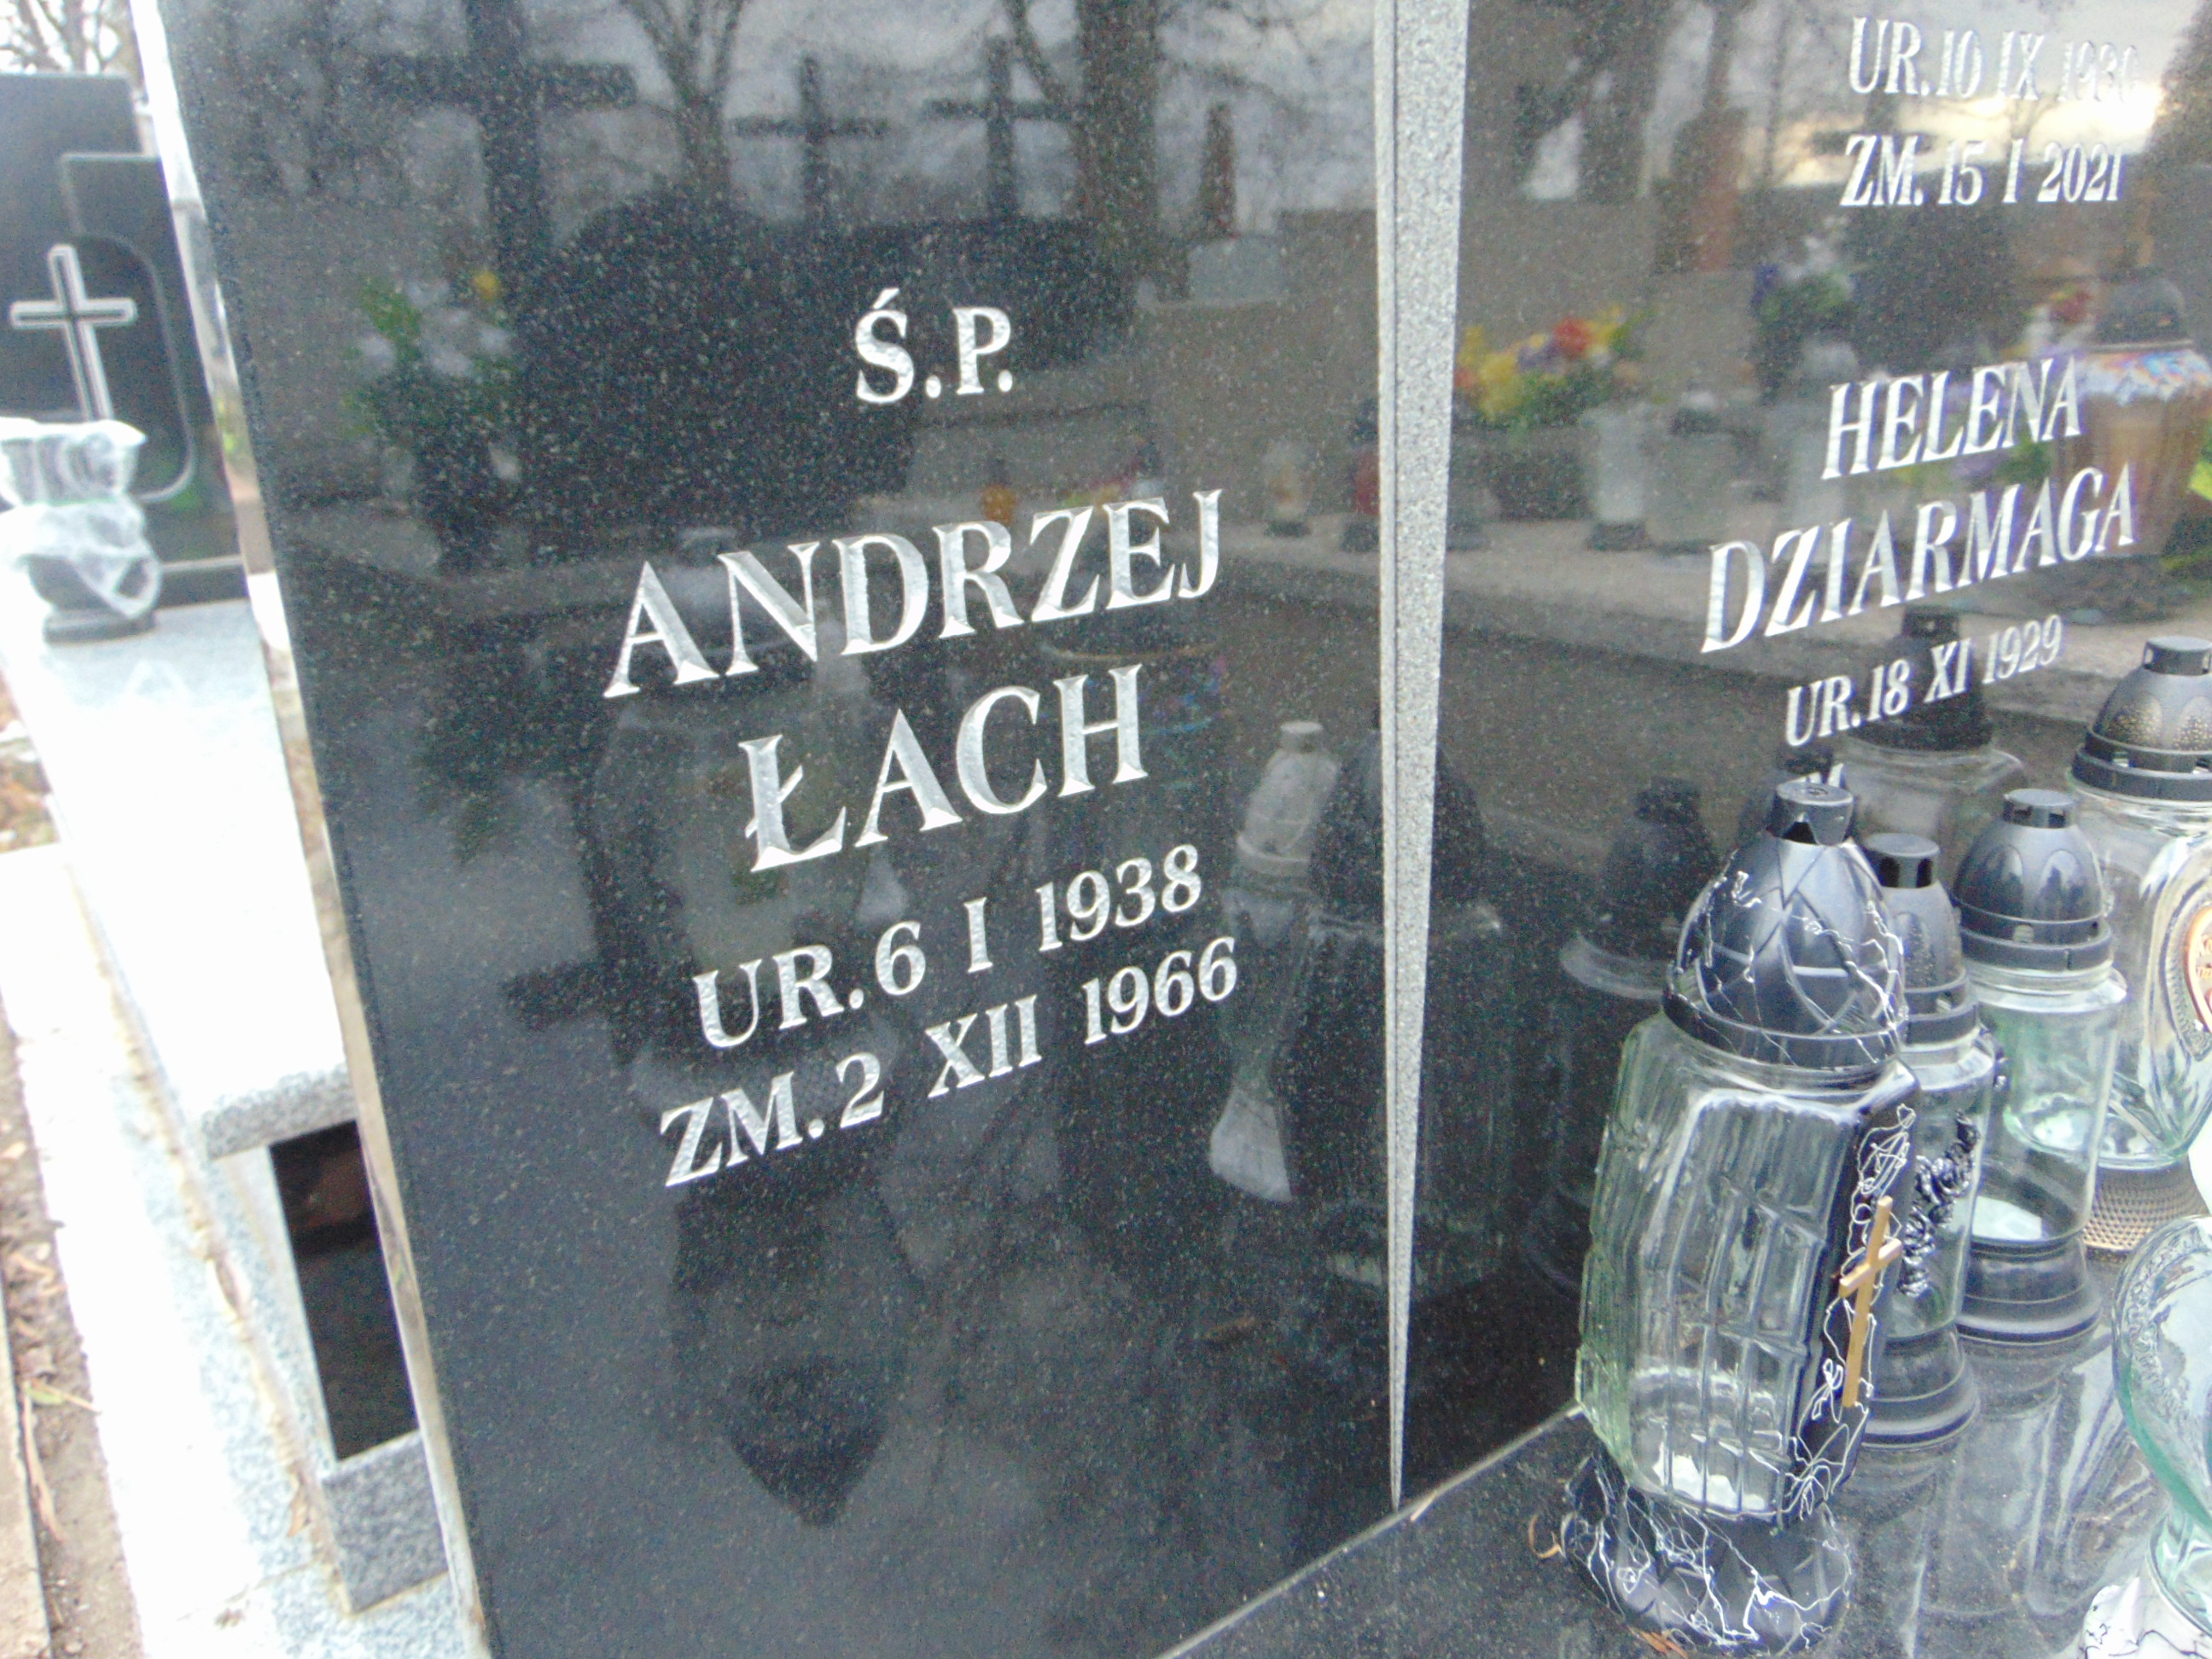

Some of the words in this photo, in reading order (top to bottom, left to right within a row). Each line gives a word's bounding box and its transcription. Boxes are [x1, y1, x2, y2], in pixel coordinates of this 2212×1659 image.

[1997, 32, 2045, 100] IX
[2037, 142, 2123, 203] 2021
[1822, 355, 2081, 480] HELENA
[604, 489, 1222, 698] ANDRZEJ
[1701, 463, 2134, 653] DZIARMAGA
[1924, 637, 1972, 703] XI
[1982, 614, 2063, 684] 1929
[738, 664, 1148, 872] ŁACH
[963, 897, 993, 974] I
[1036, 844, 1202, 952] 1938
[925, 995, 1042, 1098] XII
[1082, 937, 1237, 1045] 1966
